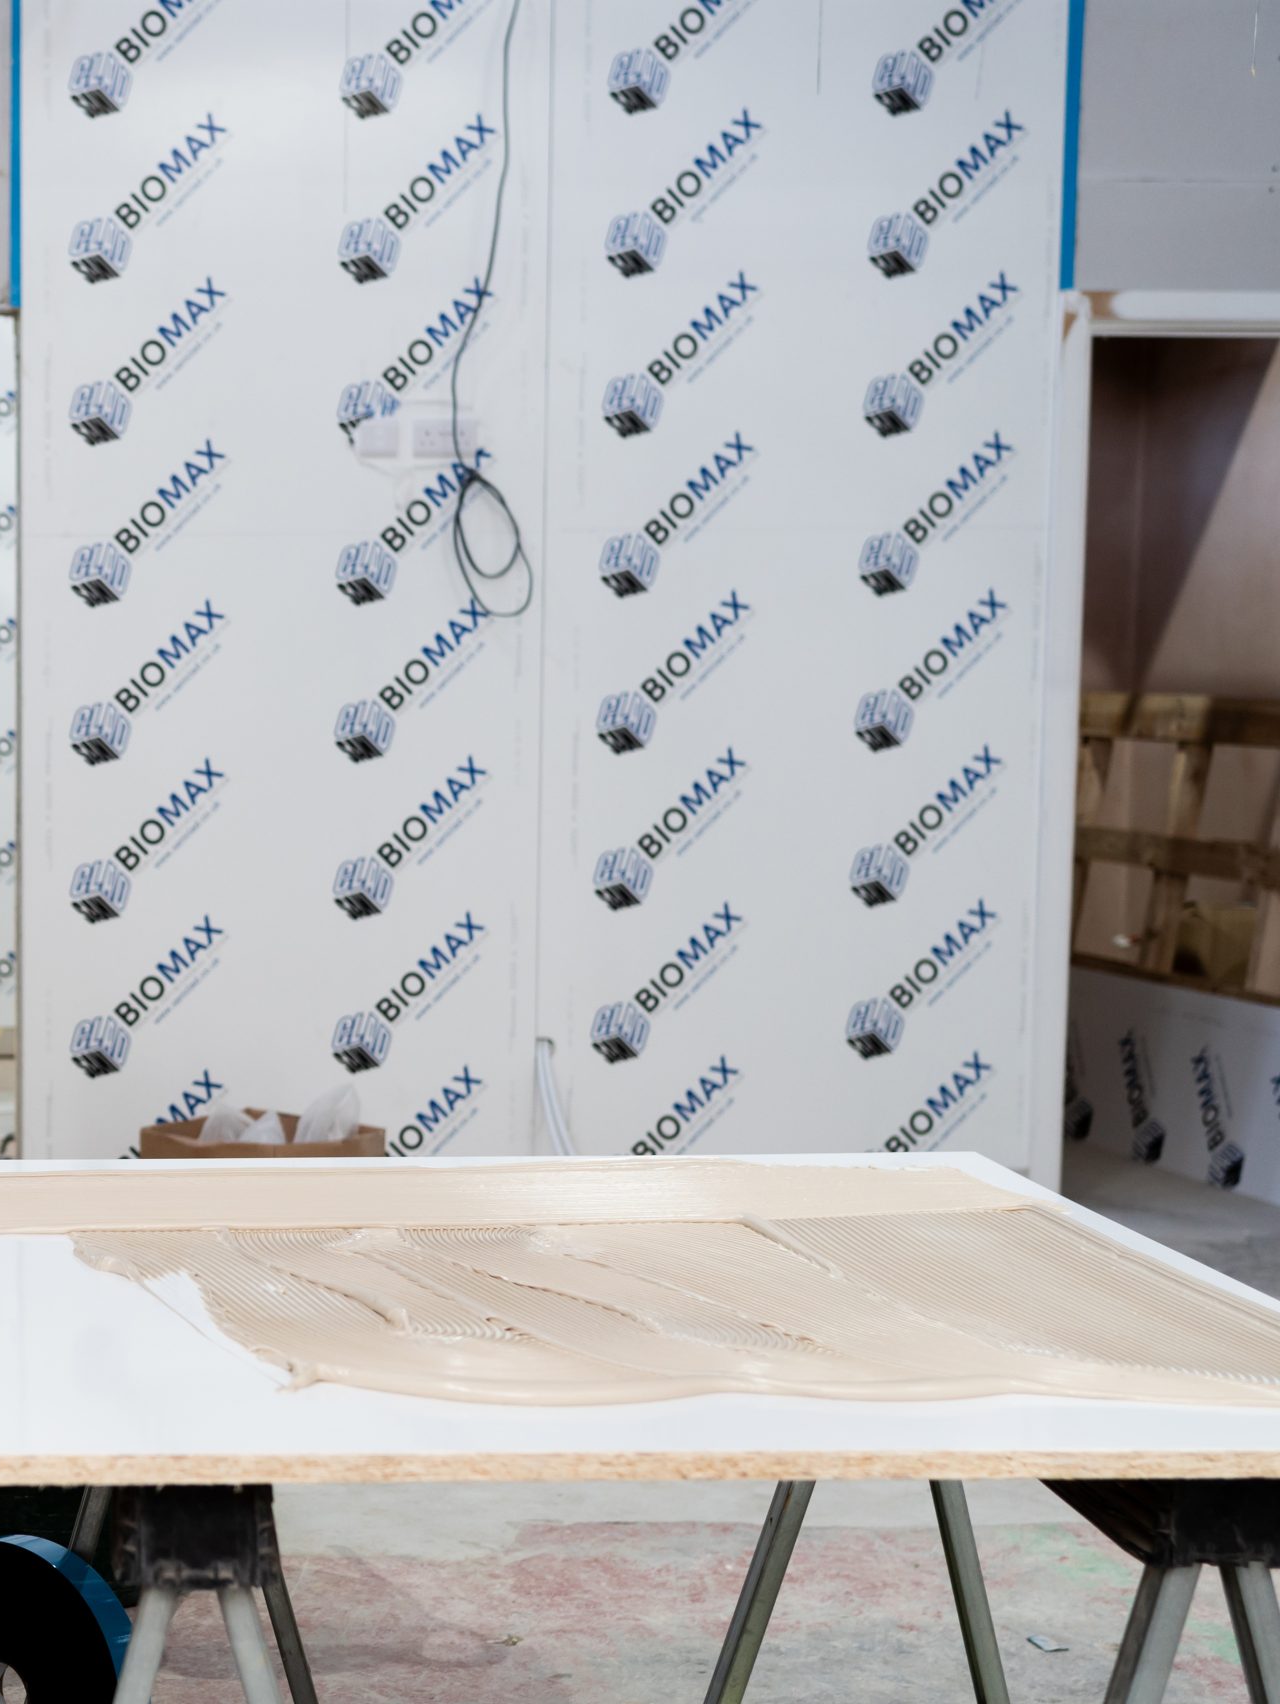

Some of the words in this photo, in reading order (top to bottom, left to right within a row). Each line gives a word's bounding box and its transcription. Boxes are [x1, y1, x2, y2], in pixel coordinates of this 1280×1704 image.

[115, 114, 226, 229] BIOMAX
[384, 115, 495, 230] BIOMAX
[651, 110, 761, 224] BIOMAX
[913, 110, 1023, 225] BIOMAX
[114, 278, 225, 392] BIOMAX
[382, 277, 493, 391] BIOMAX
[648, 272, 757, 386] BIOMAX
[908, 273, 1017, 385] BIOMAX
[114, 440, 225, 554] BIOMAX
[644, 432, 753, 546] BIOMAX
[903, 432, 1011, 544] BIOMAX
[114, 600, 224, 714] BIOMAX
[379, 598, 489, 711] BIOMAX
[641, 591, 749, 703] BIOMAX
[898, 590, 1006, 701] BIOMAX
[114, 758, 224, 872] BIOMAX
[377, 756, 486, 868] BIOMAX
[638, 748, 745, 859] BIOMAX
[894, 746, 1000, 856] BIOMAX
[114, 915, 223, 1027] BIOMAX
[375, 912, 484, 1022] BIOMAX
[634, 903, 741, 1013] BIOMAX
[889, 900, 995, 1009] BIOMAX
